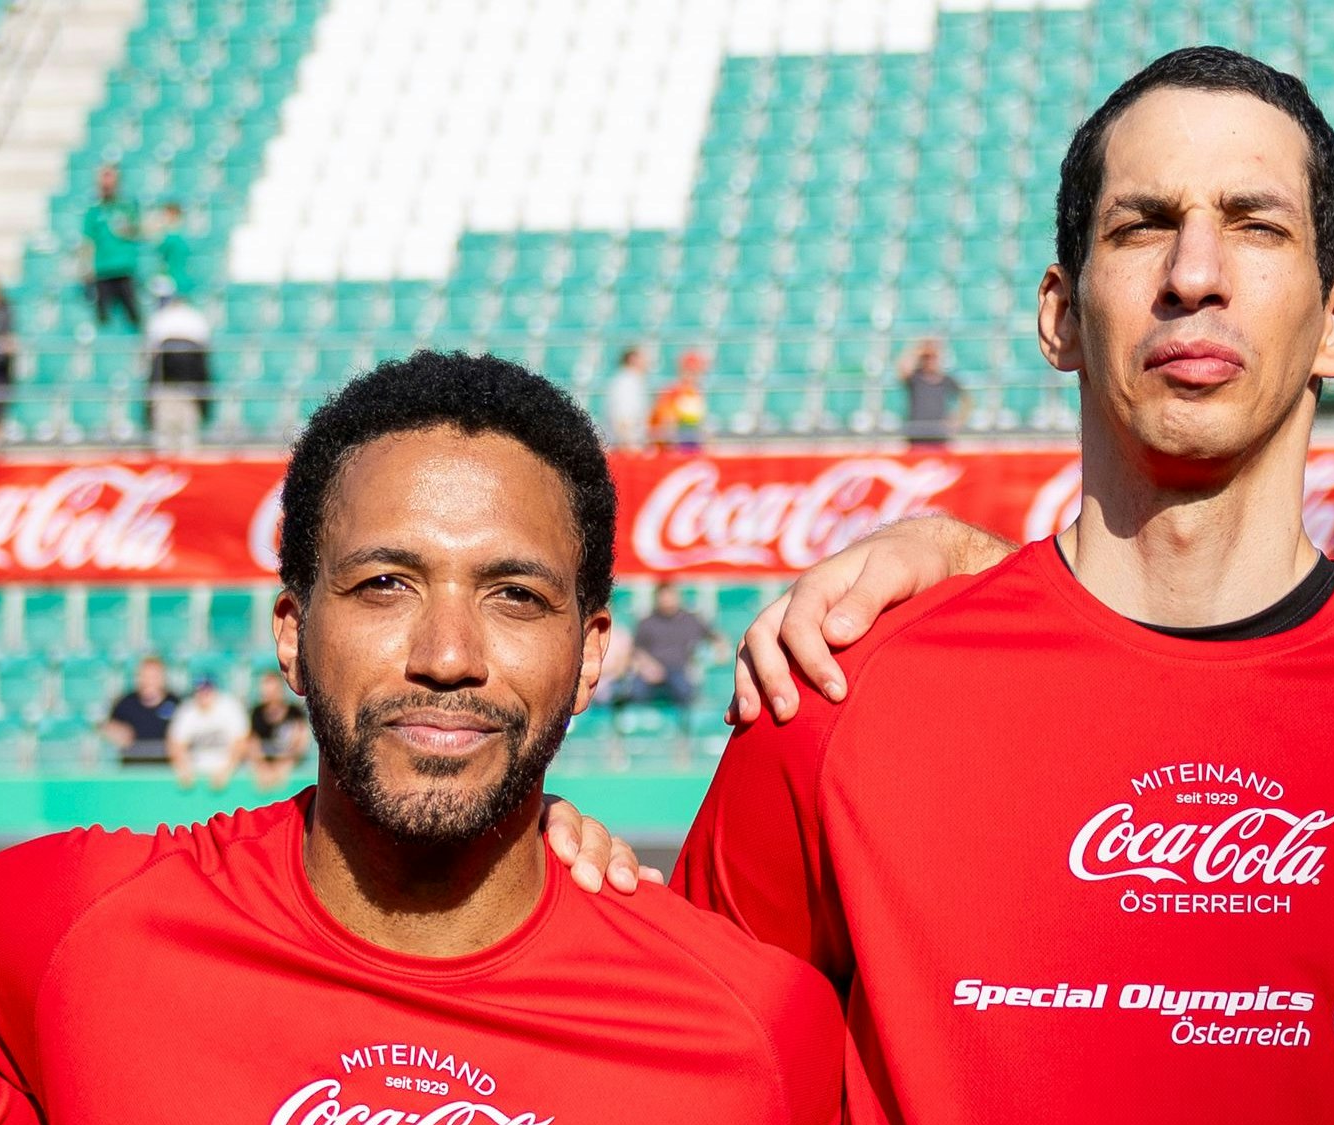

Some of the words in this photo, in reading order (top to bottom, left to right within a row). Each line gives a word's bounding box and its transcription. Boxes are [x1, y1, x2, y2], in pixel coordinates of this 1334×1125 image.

[1131, 763, 1284, 801] MITEINAND
[1175, 791, 1202, 805] seit
[1205, 792, 1238, 805] 1929
[1120, 889, 1291, 914] ÖSTERREICH
[953, 979, 1108, 1011] Special
[1119, 984, 1314, 1016] Olympics
[1171, 1015, 1311, 1047] Österreich
[340, 1043, 496, 1097] MITEINAND
[385, 1074, 413, 1091] seit
[415, 1077, 449, 1096] 1929
